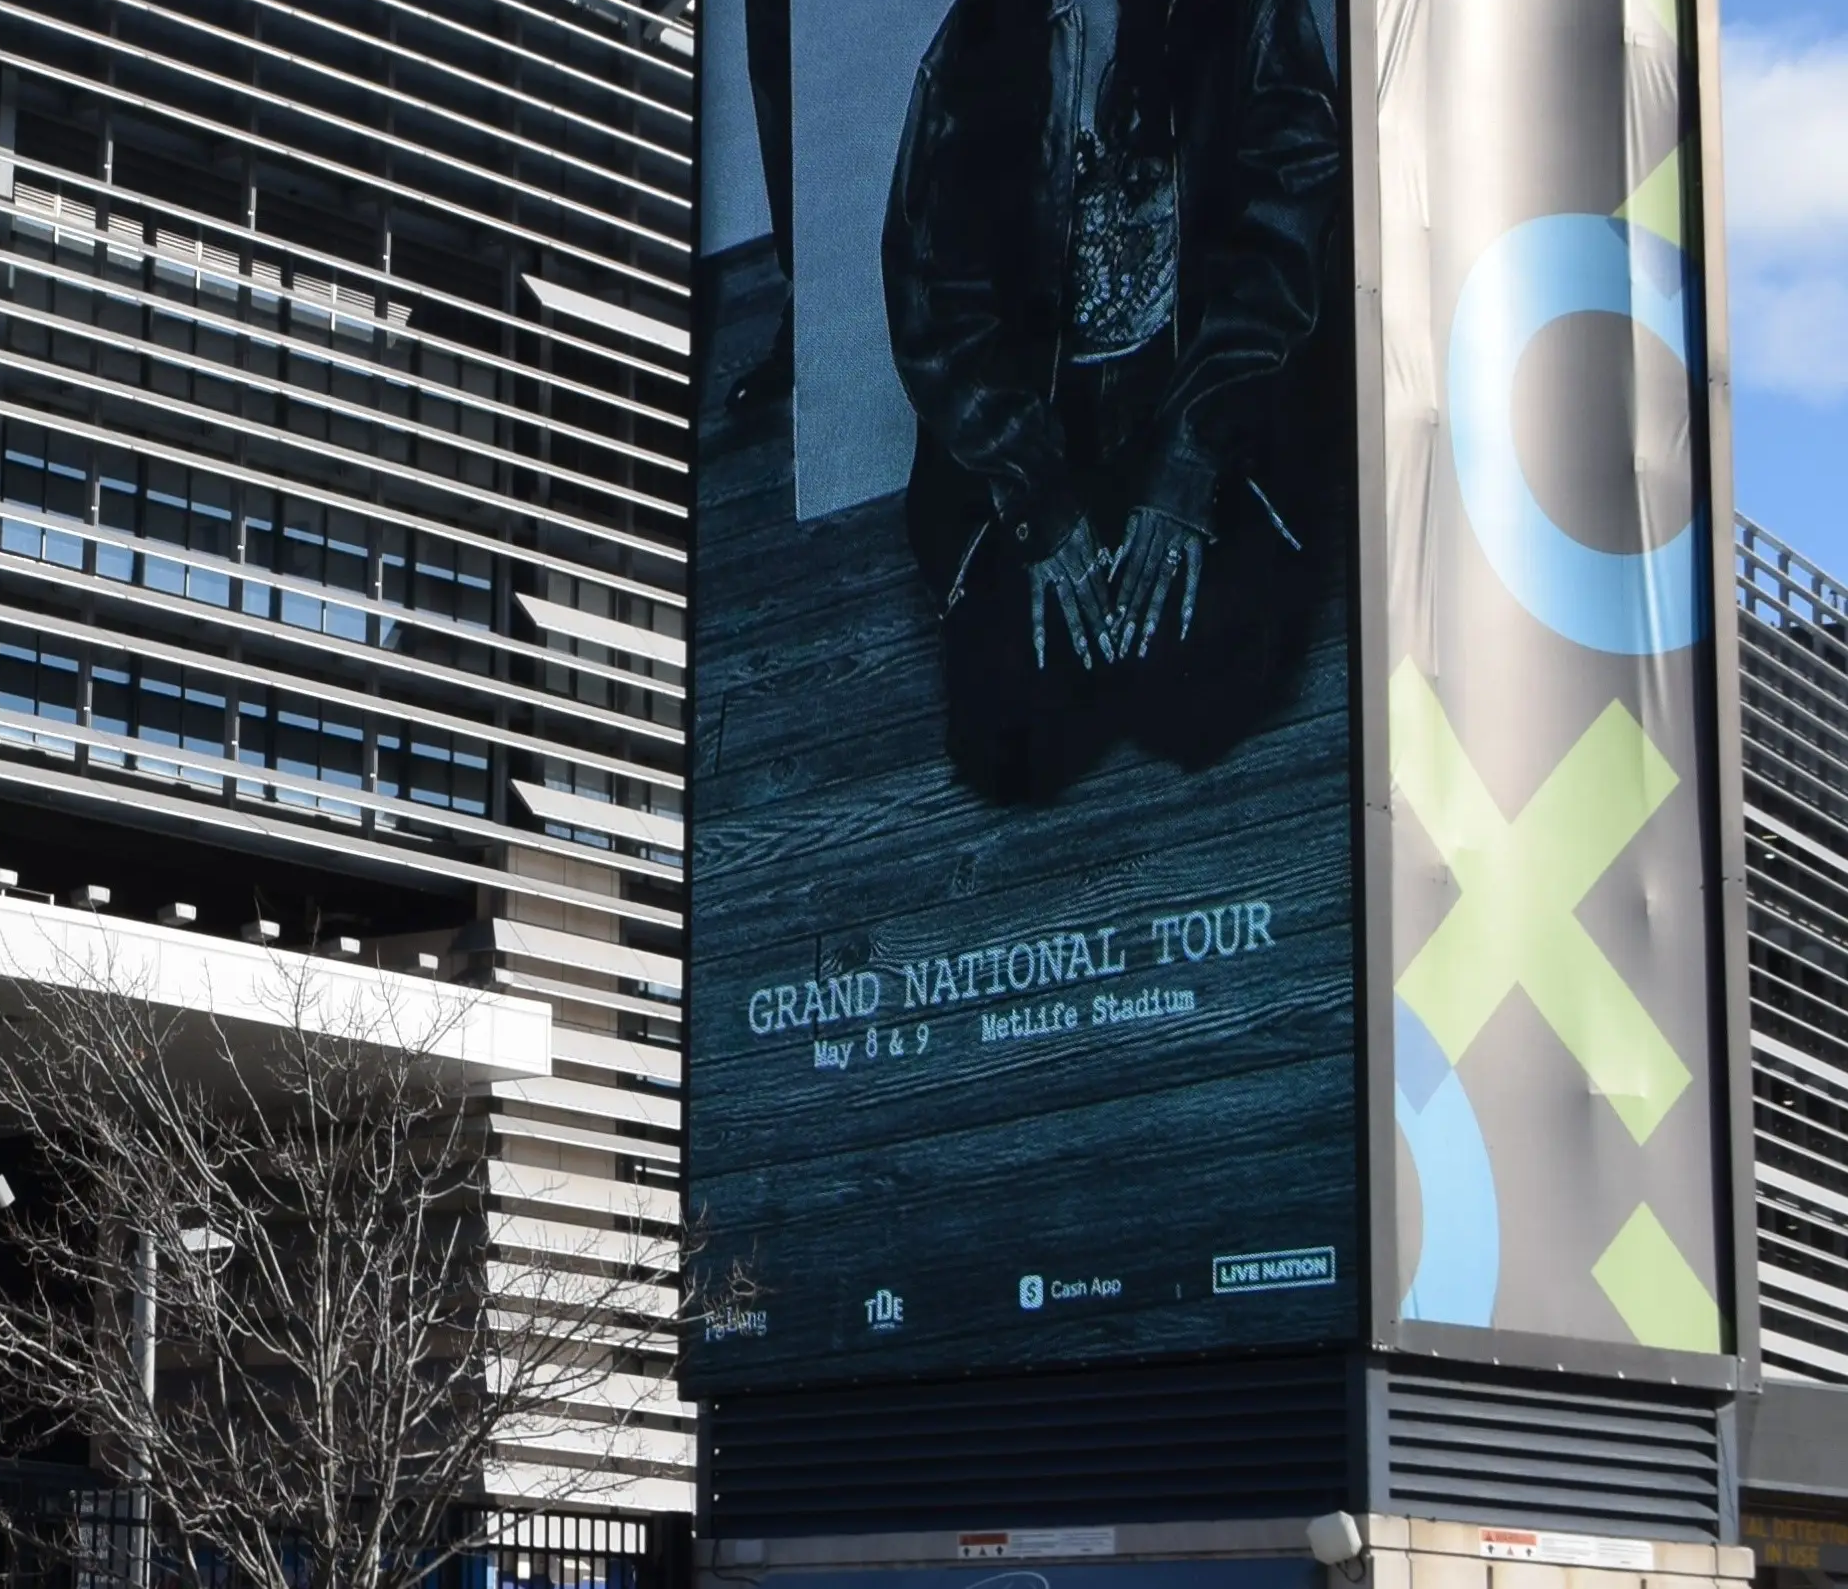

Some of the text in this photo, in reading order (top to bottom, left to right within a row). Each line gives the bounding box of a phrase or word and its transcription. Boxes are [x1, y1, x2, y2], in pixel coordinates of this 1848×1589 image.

[749, 900, 1276, 1035] GRAND NATIONAL TOUR
[814, 987, 1196, 1070] May 8 & 9 MetLife Stadium
[1051, 1277, 1123, 1300] Cash App
[1220, 1256, 1328, 1285] LIVE NATION
[863, 1288, 904, 1325] TDE
